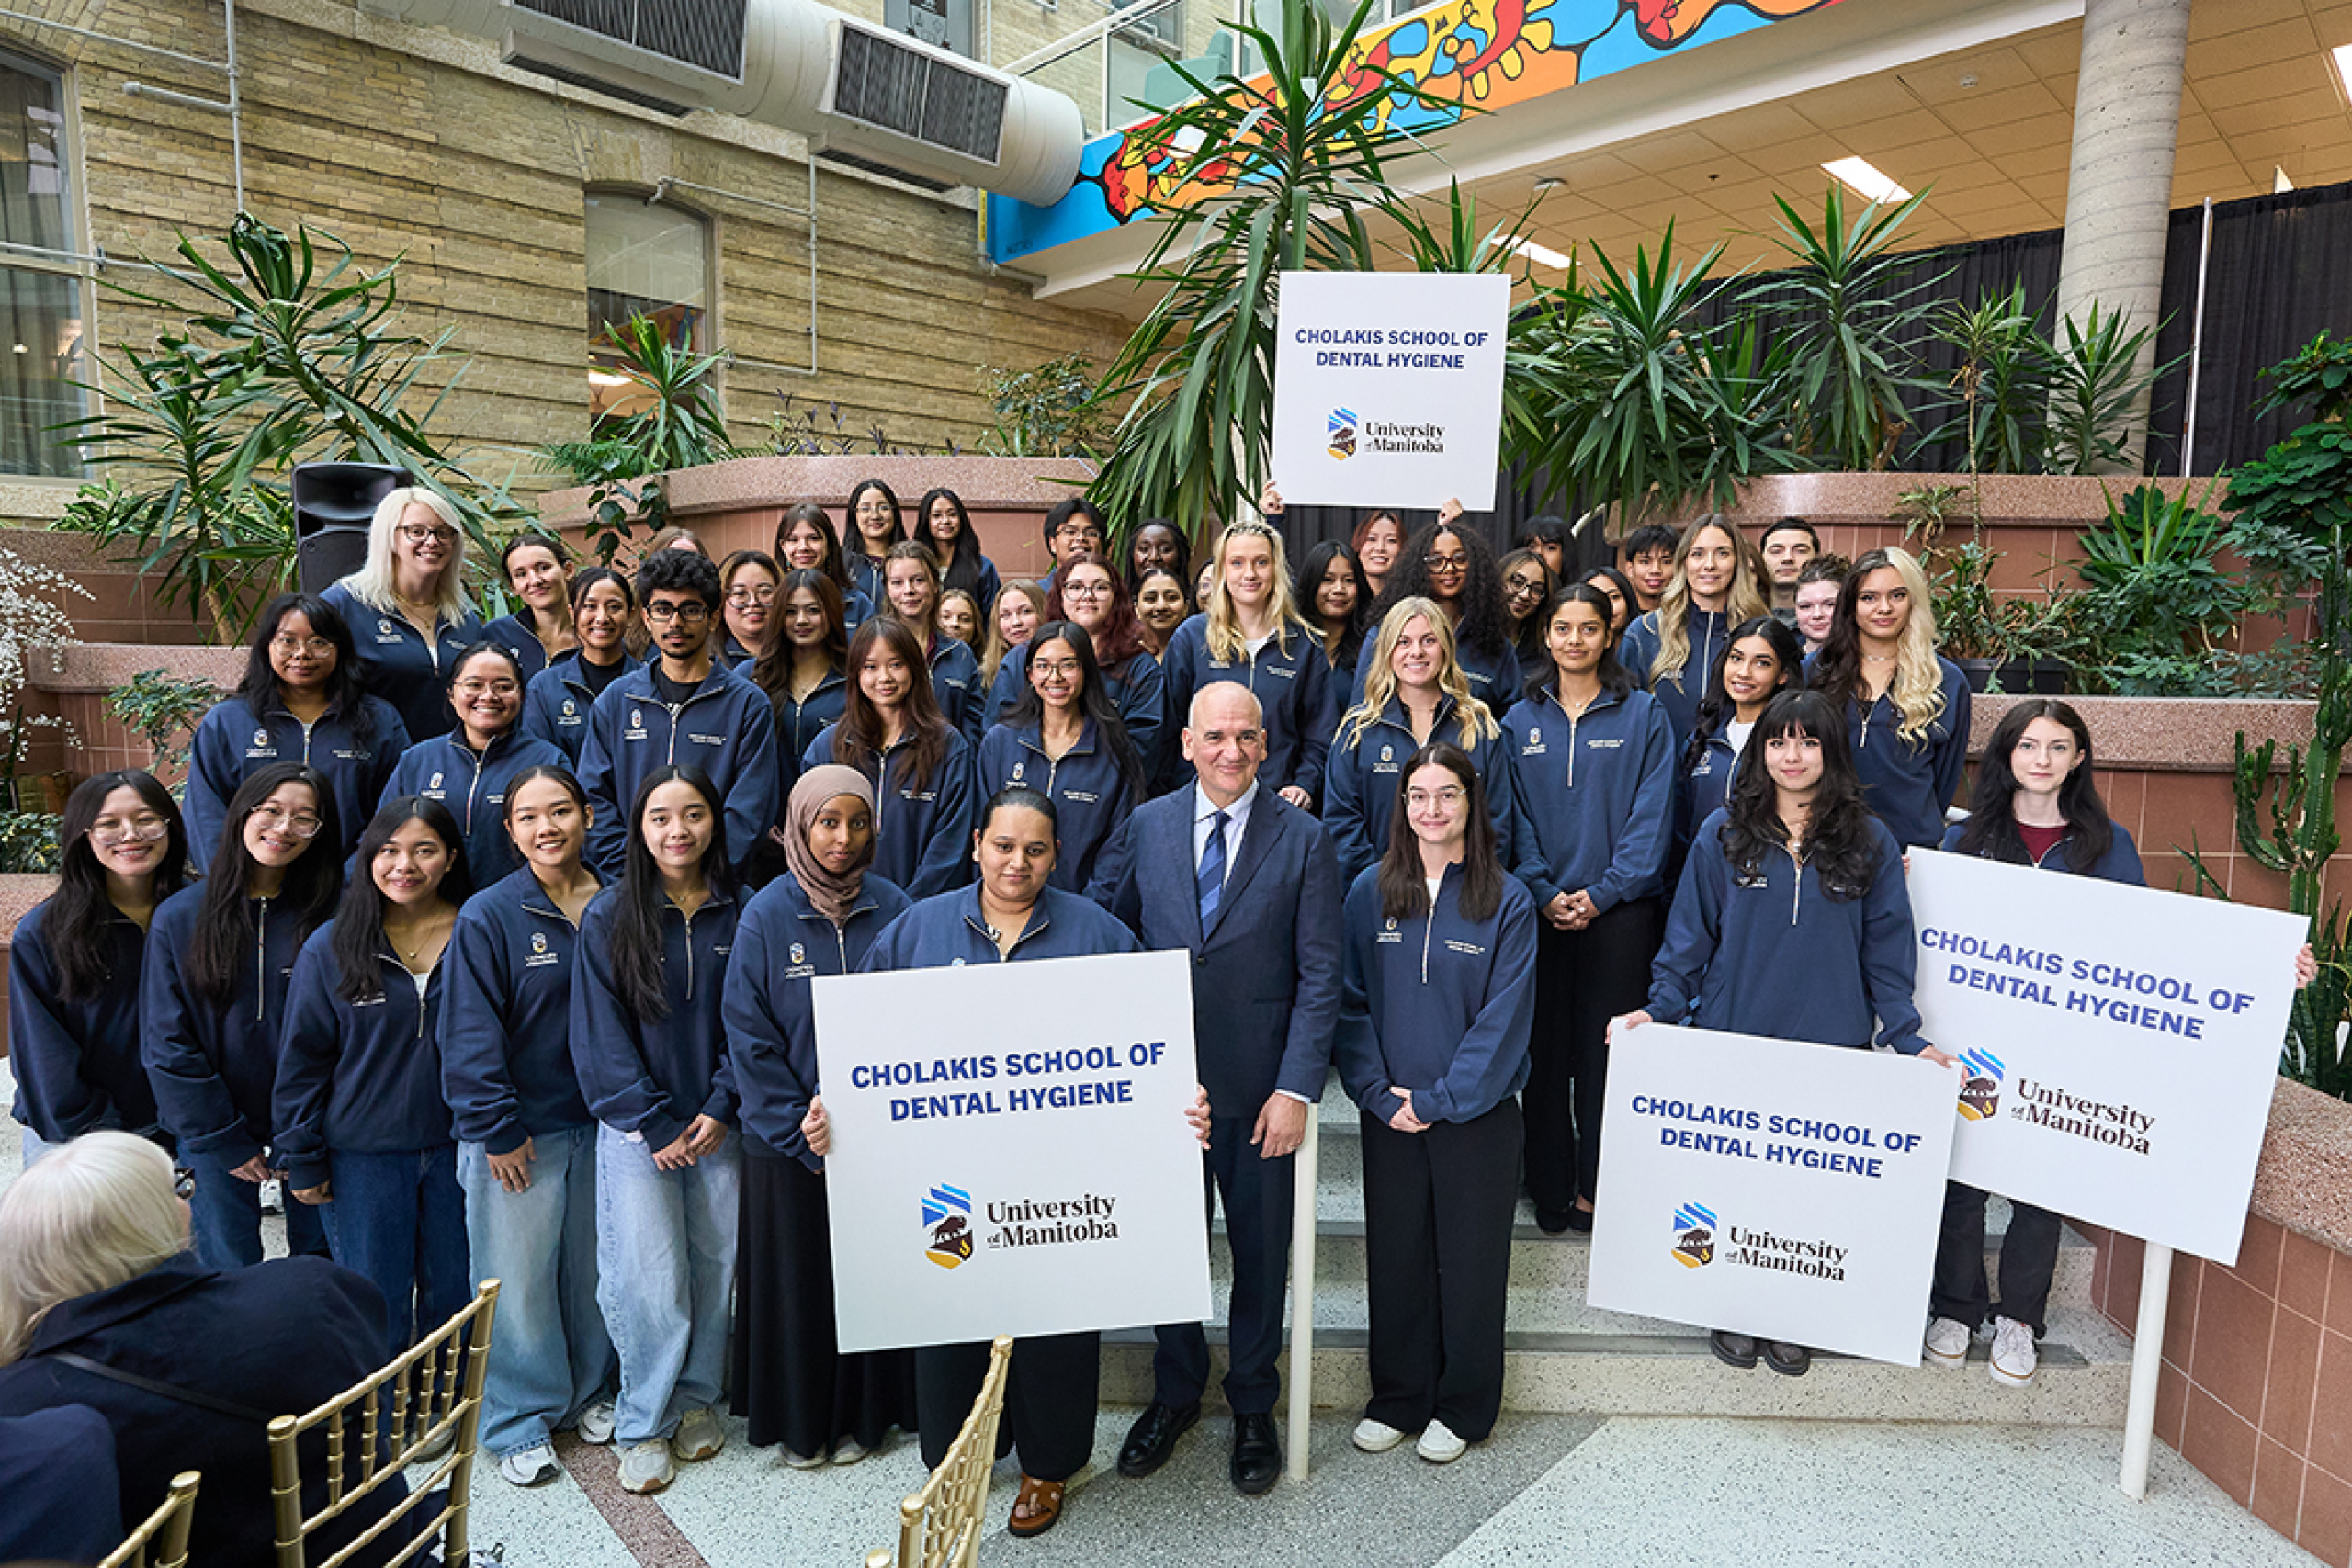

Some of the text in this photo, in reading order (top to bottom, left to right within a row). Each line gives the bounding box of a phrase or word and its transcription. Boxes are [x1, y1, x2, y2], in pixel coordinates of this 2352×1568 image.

[1295, 328, 1488, 346] CHOLAKIS SCHOOL OF
[1316, 351, 1464, 369] DENTAL HYGIENE
[1366, 423, 1445, 441] University
[1373, 437, 1443, 452] Manitoba
[1921, 928, 2255, 1014] CHOLAKIS SCHOOL OF
[1948, 964, 2205, 1040] DENTAL HYGIENE
[851, 1042, 1166, 1089] CHOLAKIS SCHOOL OF
[889, 1080, 1133, 1121] DENTAL HYGIENE
[2018, 1077, 2156, 1134] University
[1632, 1095, 1922, 1153] CHOLAKIS SCHOOL OF
[2026, 1103, 2150, 1156] Manitoba
[1661, 1127, 1883, 1178] DENTAL HYGIENE
[987, 1193, 1116, 1224] University
[1001, 1218, 1118, 1247] Manitoba
[1730, 1225, 1849, 1266] University
[1739, 1247, 1845, 1281] Manitoba
